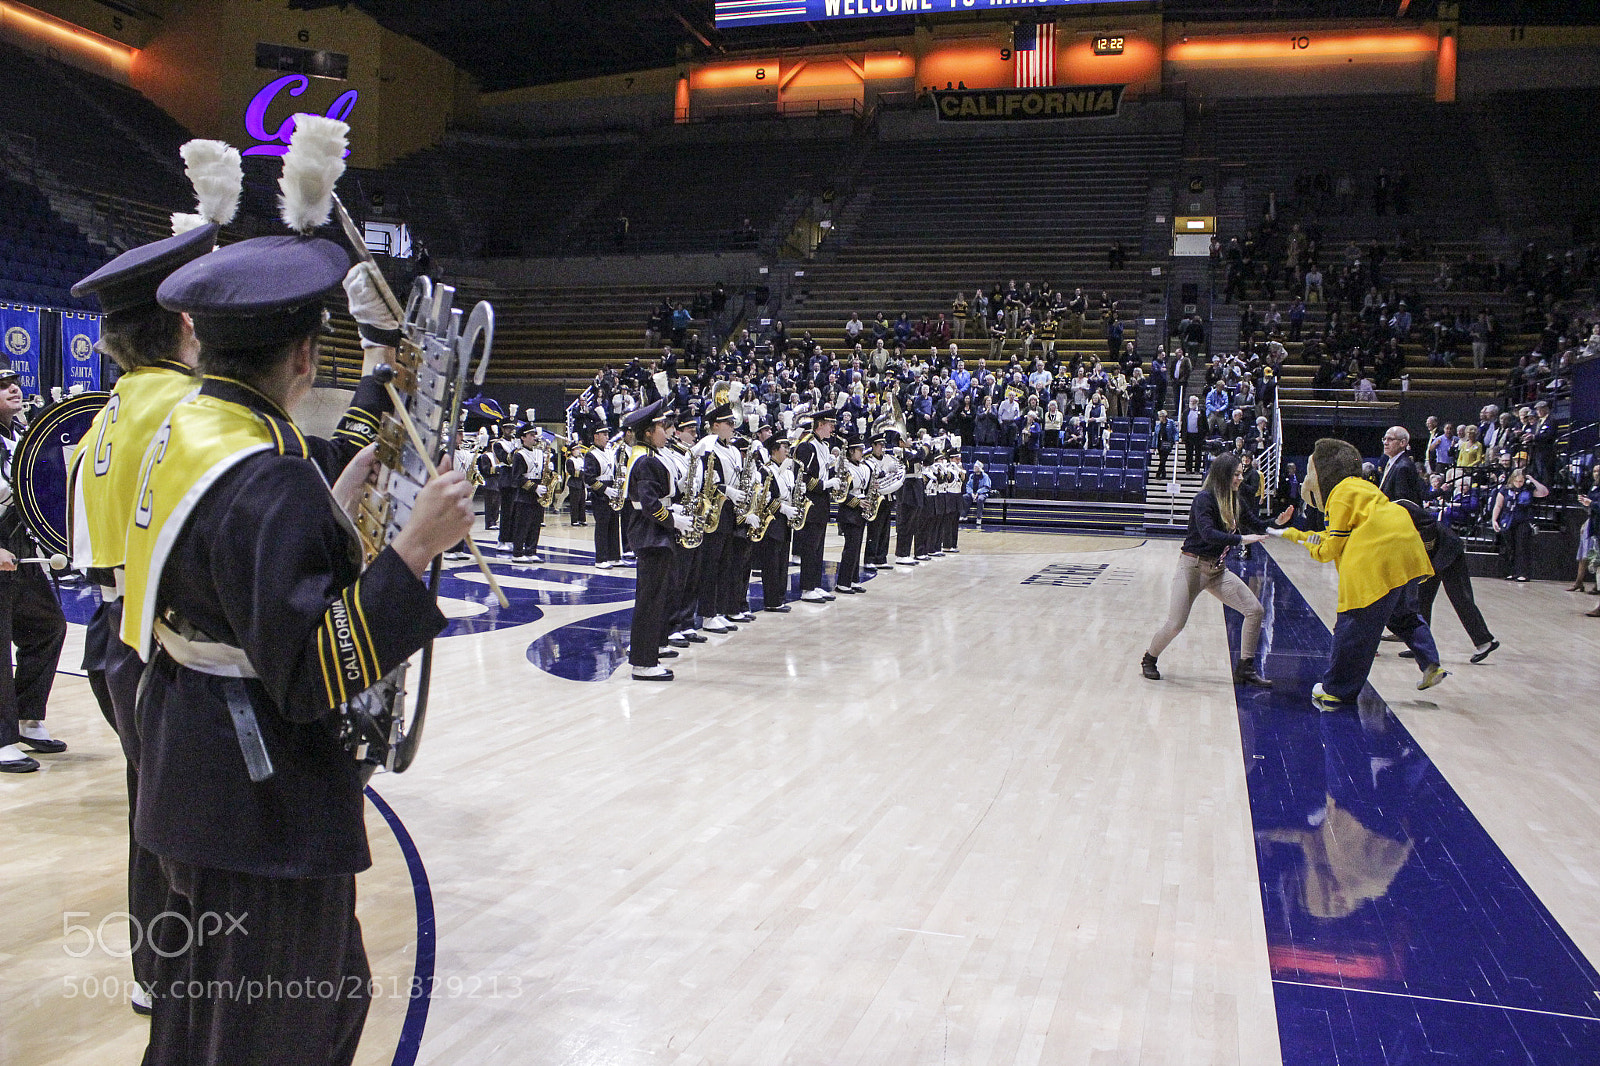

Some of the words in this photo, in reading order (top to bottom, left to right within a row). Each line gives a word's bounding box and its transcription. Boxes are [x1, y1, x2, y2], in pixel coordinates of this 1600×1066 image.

[297, 29, 310, 43] 6
[1097, 38, 1124, 49] 12:22
[1291, 36, 1310, 50] 10
[1000, 48, 1011, 61] 9
[755, 67, 766, 80] 8
[624, 77, 635, 89] 7
[940, 89, 1114, 117] CALIFORNIA
[10, 360, 30, 373] ANTA
[70, 366, 93, 378] SANTA
[20, 375, 36, 388] ARA
[60, 432, 71, 444] C
[93, 392, 121, 478] C
[135, 424, 172, 530] C
[331, 598, 360, 681] CALIFORNIA
